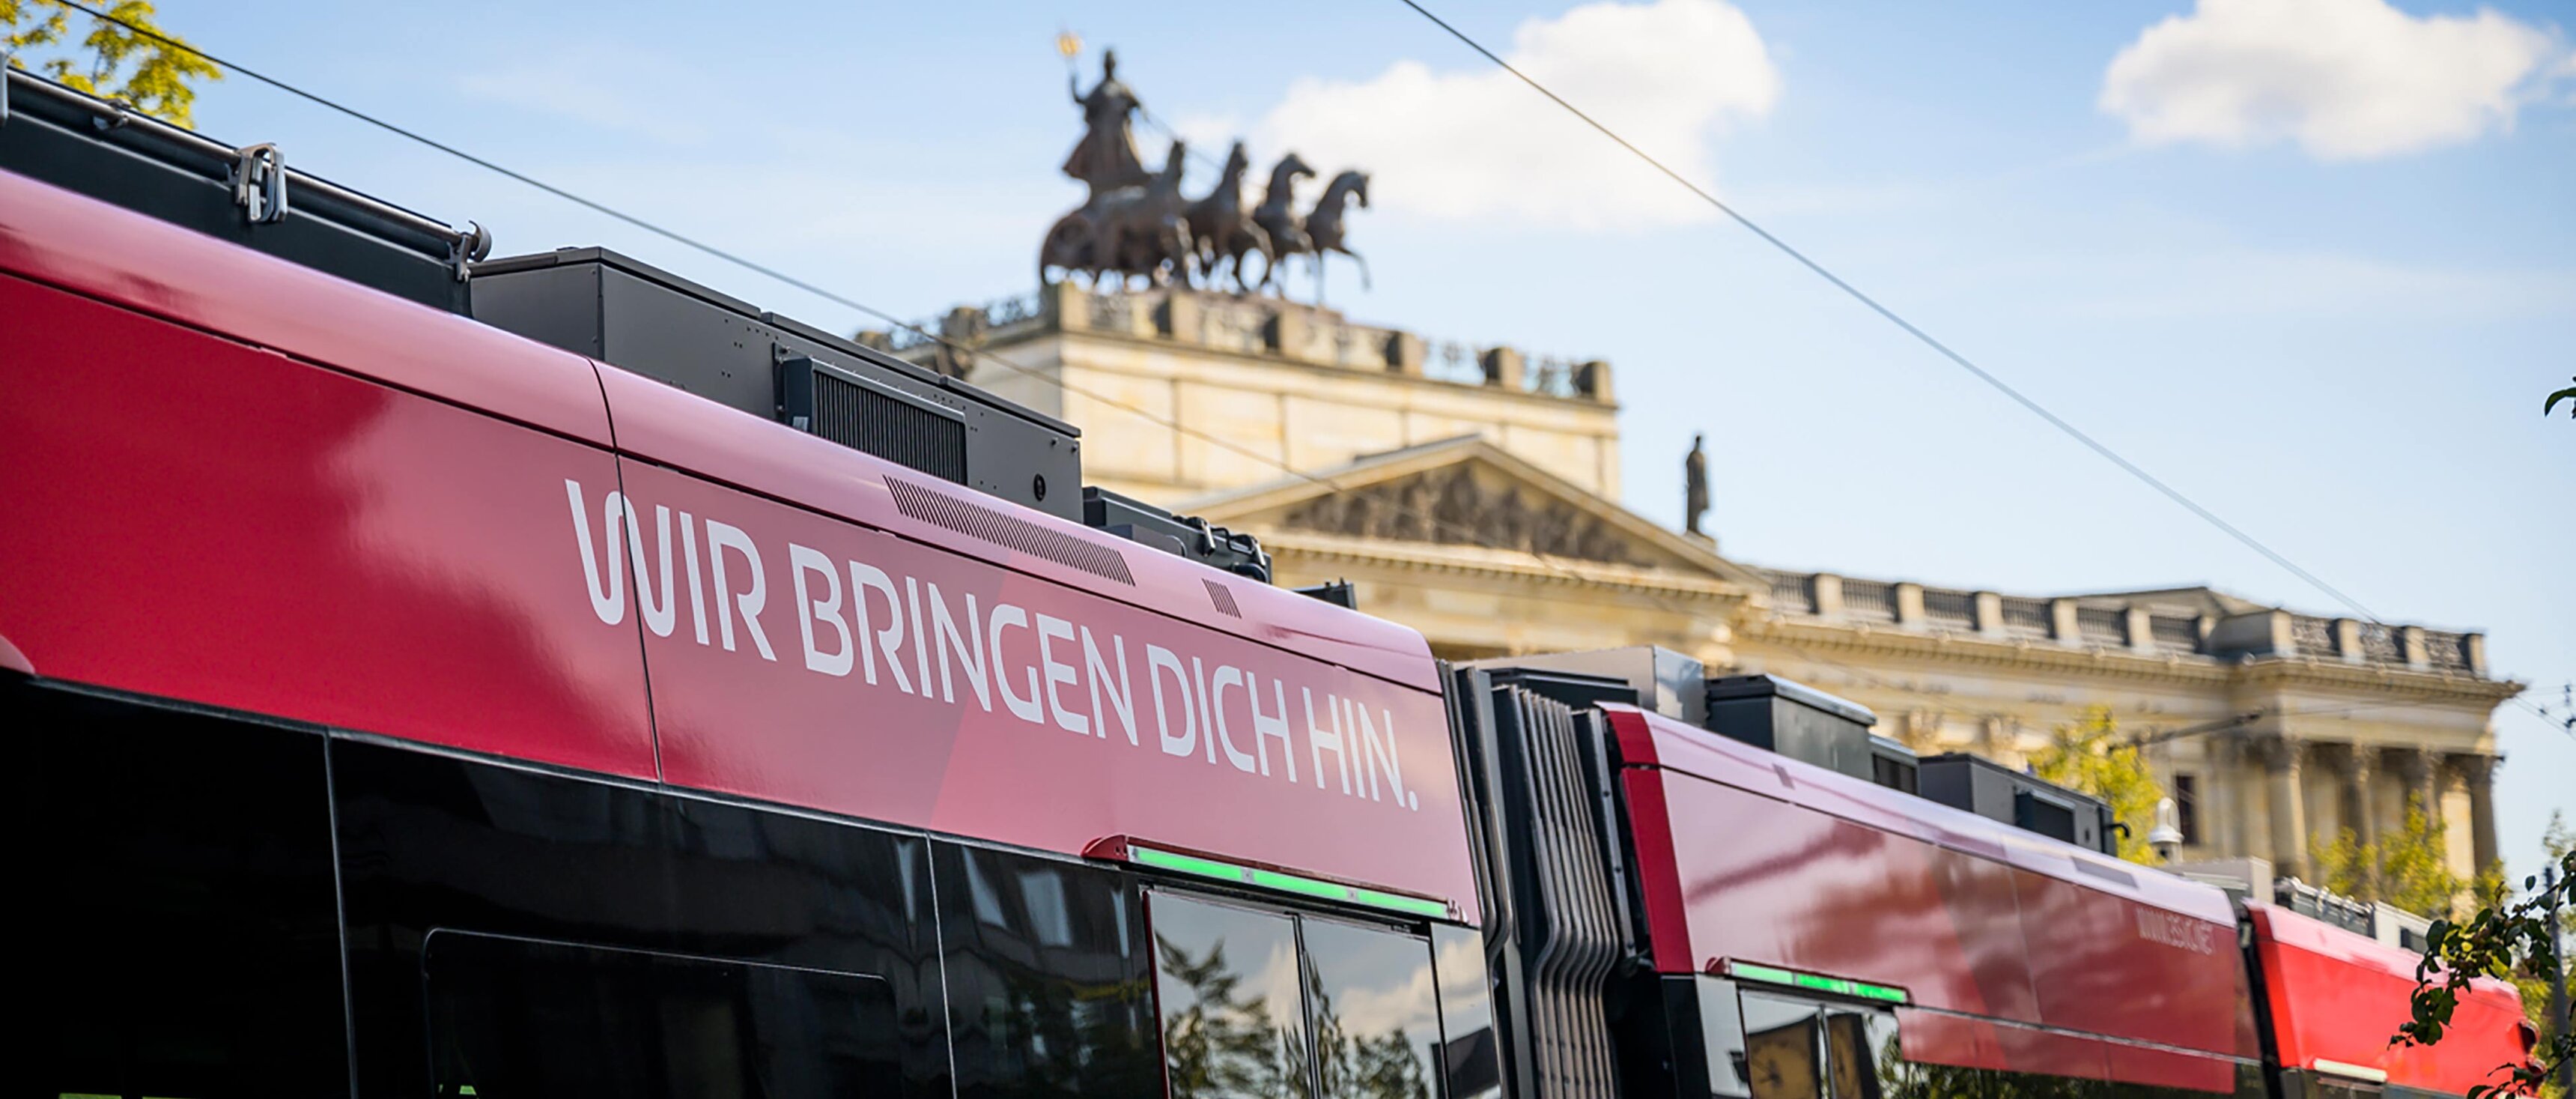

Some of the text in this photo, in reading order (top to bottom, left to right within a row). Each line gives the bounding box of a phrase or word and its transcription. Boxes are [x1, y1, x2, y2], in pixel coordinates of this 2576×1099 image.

[565, 479, 1418, 811] WIR BRINGEN DICH HIN.
